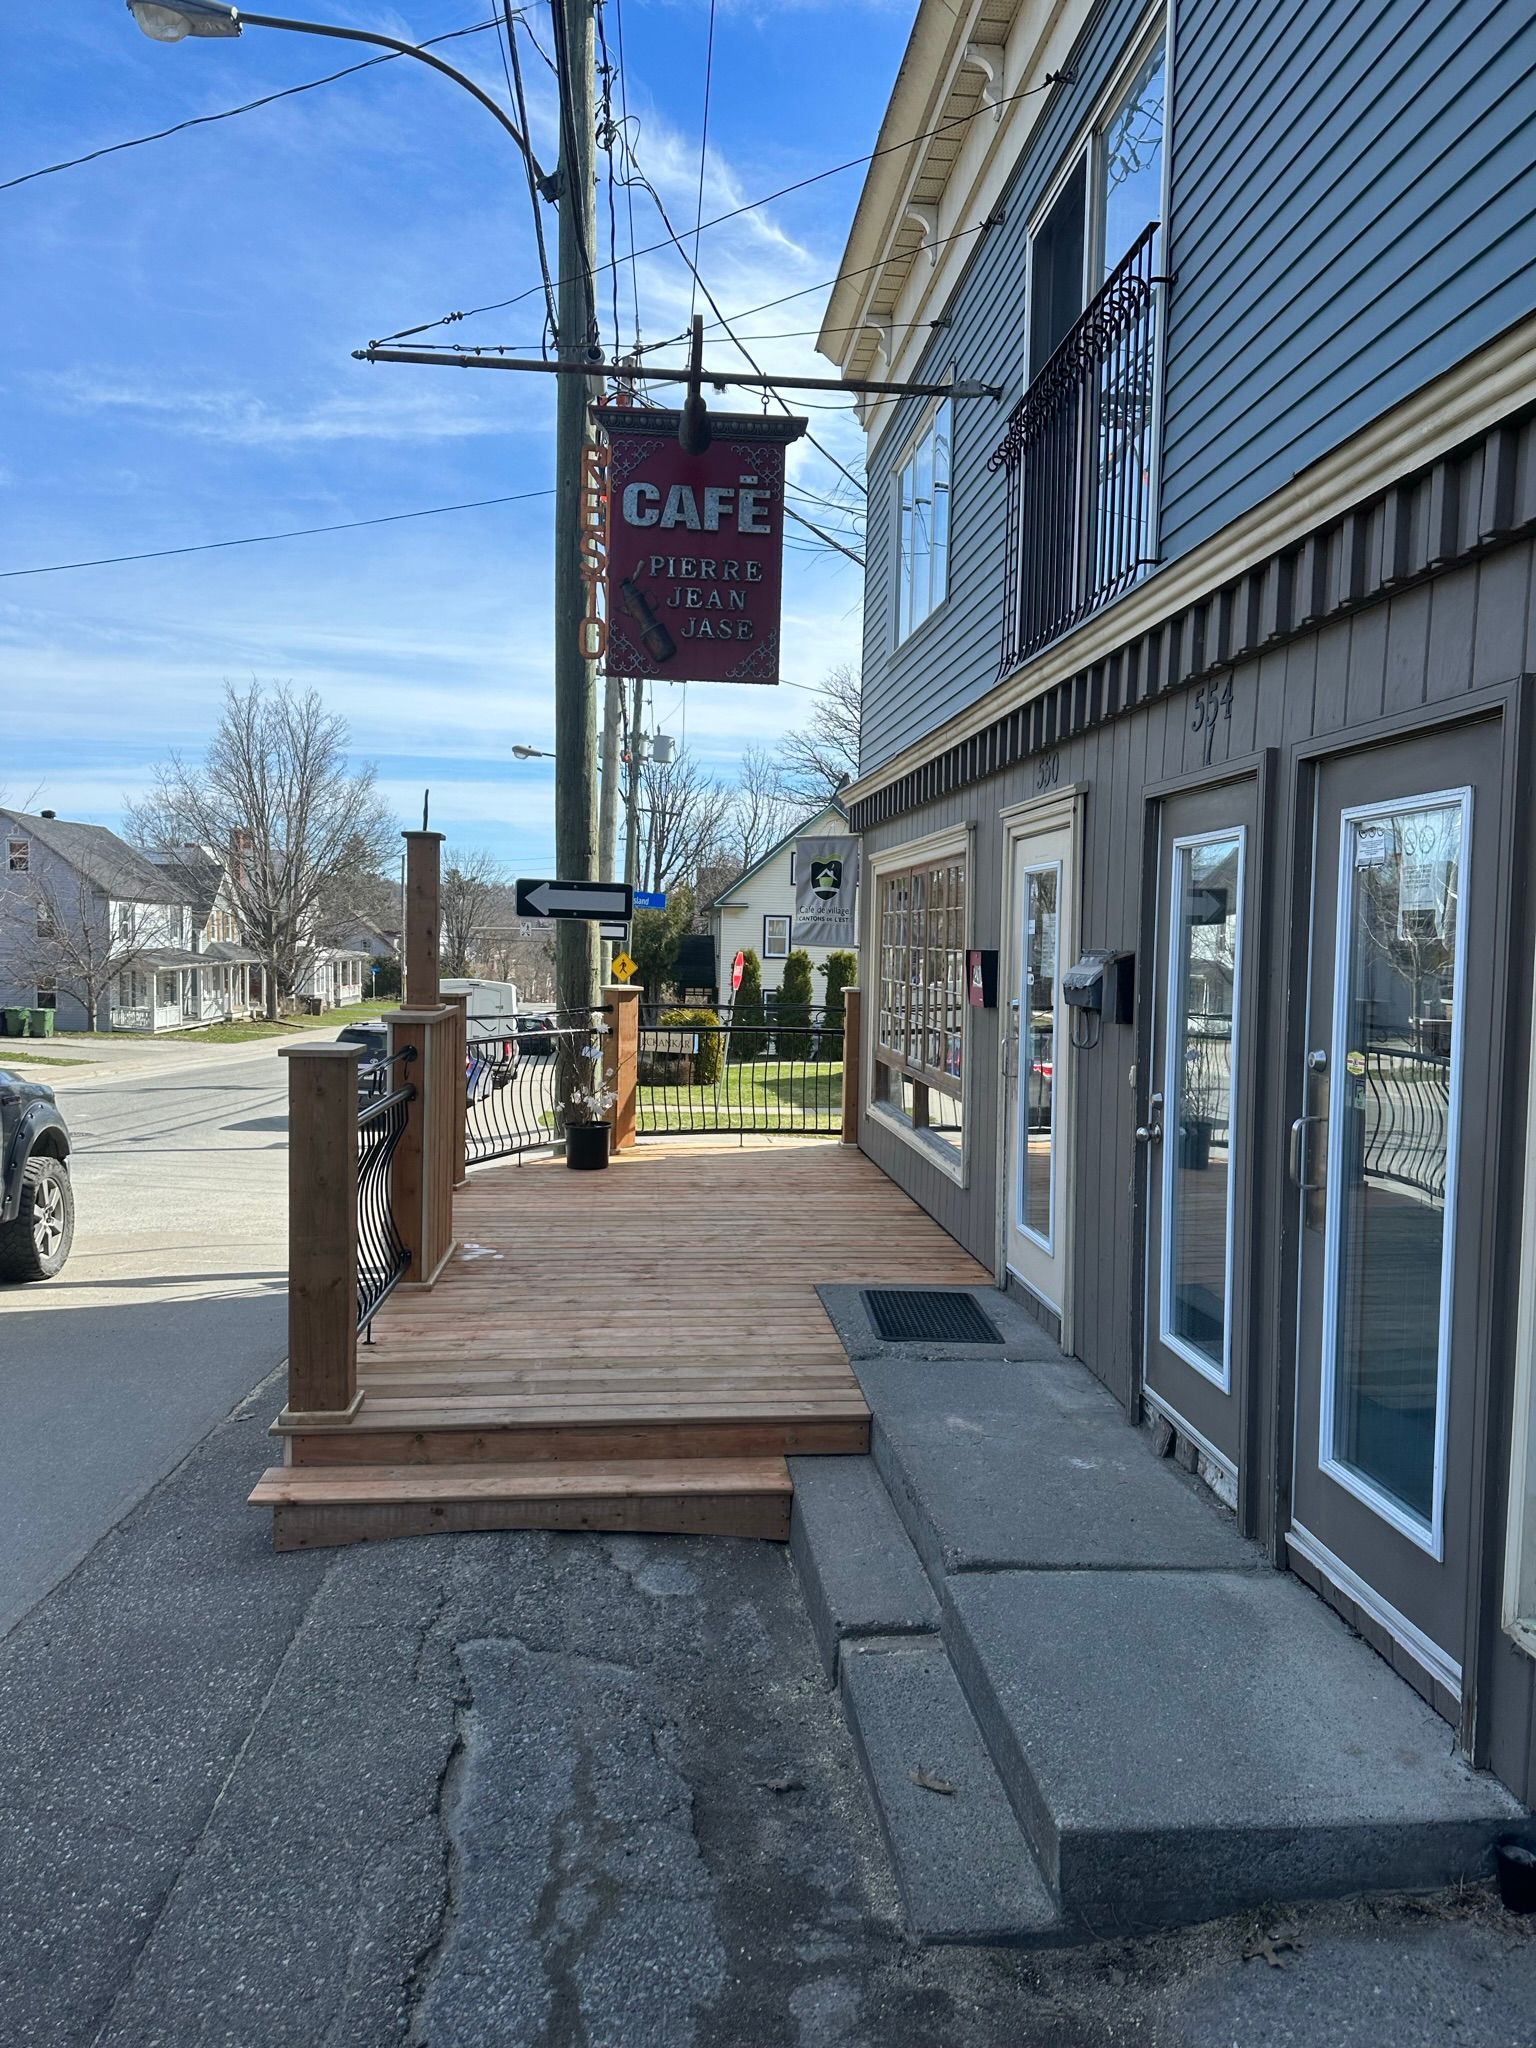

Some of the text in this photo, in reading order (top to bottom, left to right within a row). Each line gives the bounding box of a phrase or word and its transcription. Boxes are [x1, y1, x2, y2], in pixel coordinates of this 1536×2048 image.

[622, 475, 771, 534] CAFÉ
[649, 555, 762, 582] PIERRE
[667, 586, 747, 610] JEAN
[681, 617, 754, 640] JASE
[1192, 675, 1234, 732] 554
[799, 905, 849, 917] Café de village
